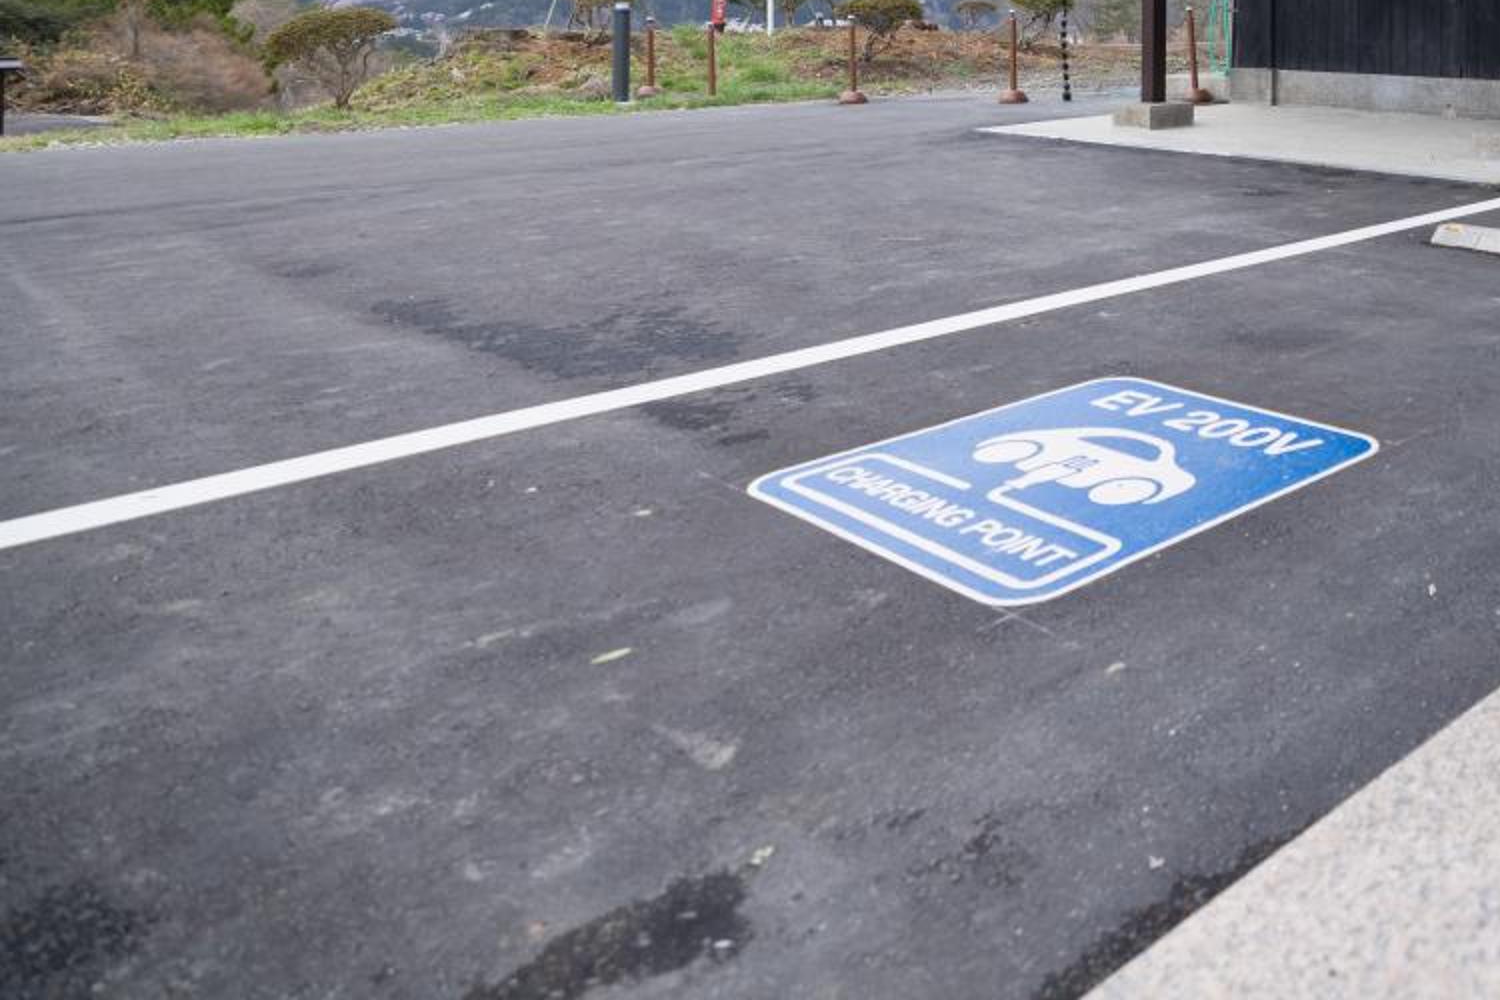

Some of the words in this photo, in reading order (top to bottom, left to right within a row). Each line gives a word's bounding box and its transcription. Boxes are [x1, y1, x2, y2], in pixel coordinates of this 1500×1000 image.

[1089, 390, 1185, 417] EV
[1162, 411, 1325, 456] 200V
[826, 466, 976, 528] CHARGING
[959, 519, 1079, 566] POINT
